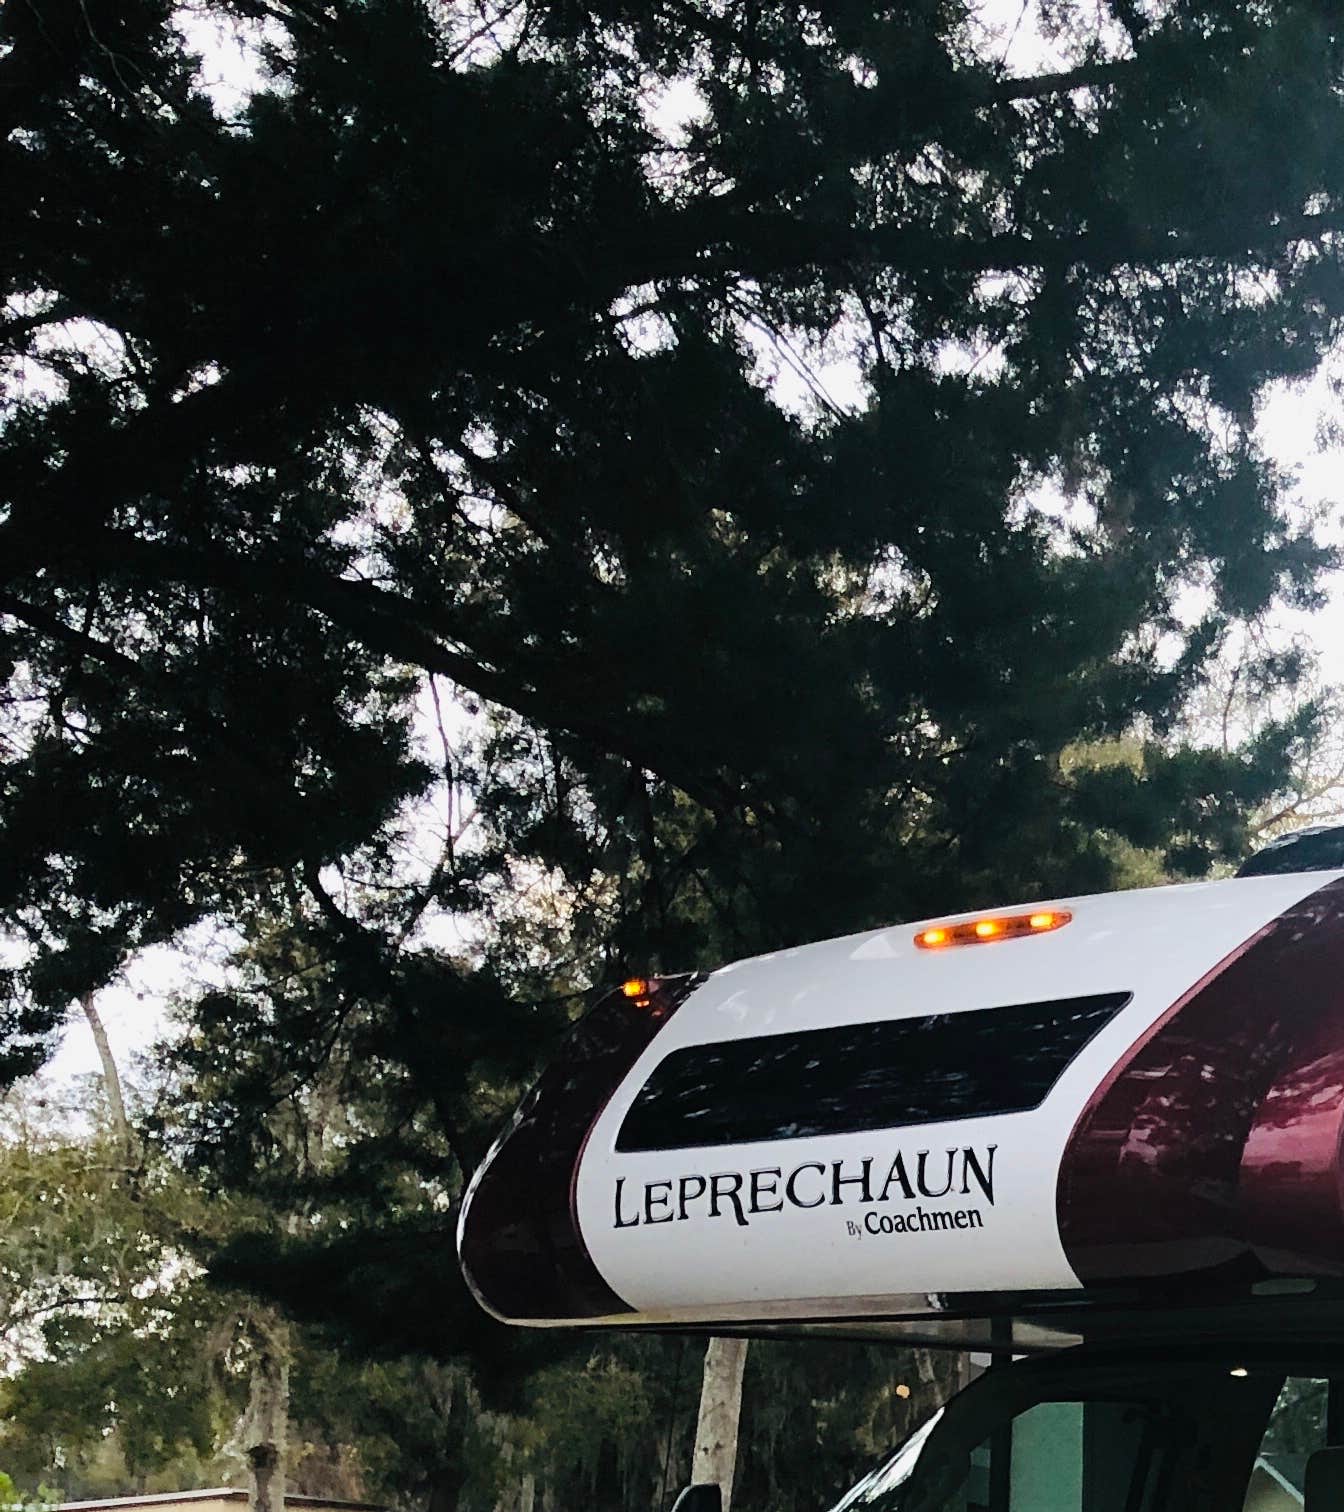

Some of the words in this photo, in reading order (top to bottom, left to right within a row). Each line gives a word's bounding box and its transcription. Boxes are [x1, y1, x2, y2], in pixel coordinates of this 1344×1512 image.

[613, 1143, 998, 1229] LEPRECHAUN
[846, 1220, 863, 1241] By
[864, 1206, 984, 1235] Coachmen
